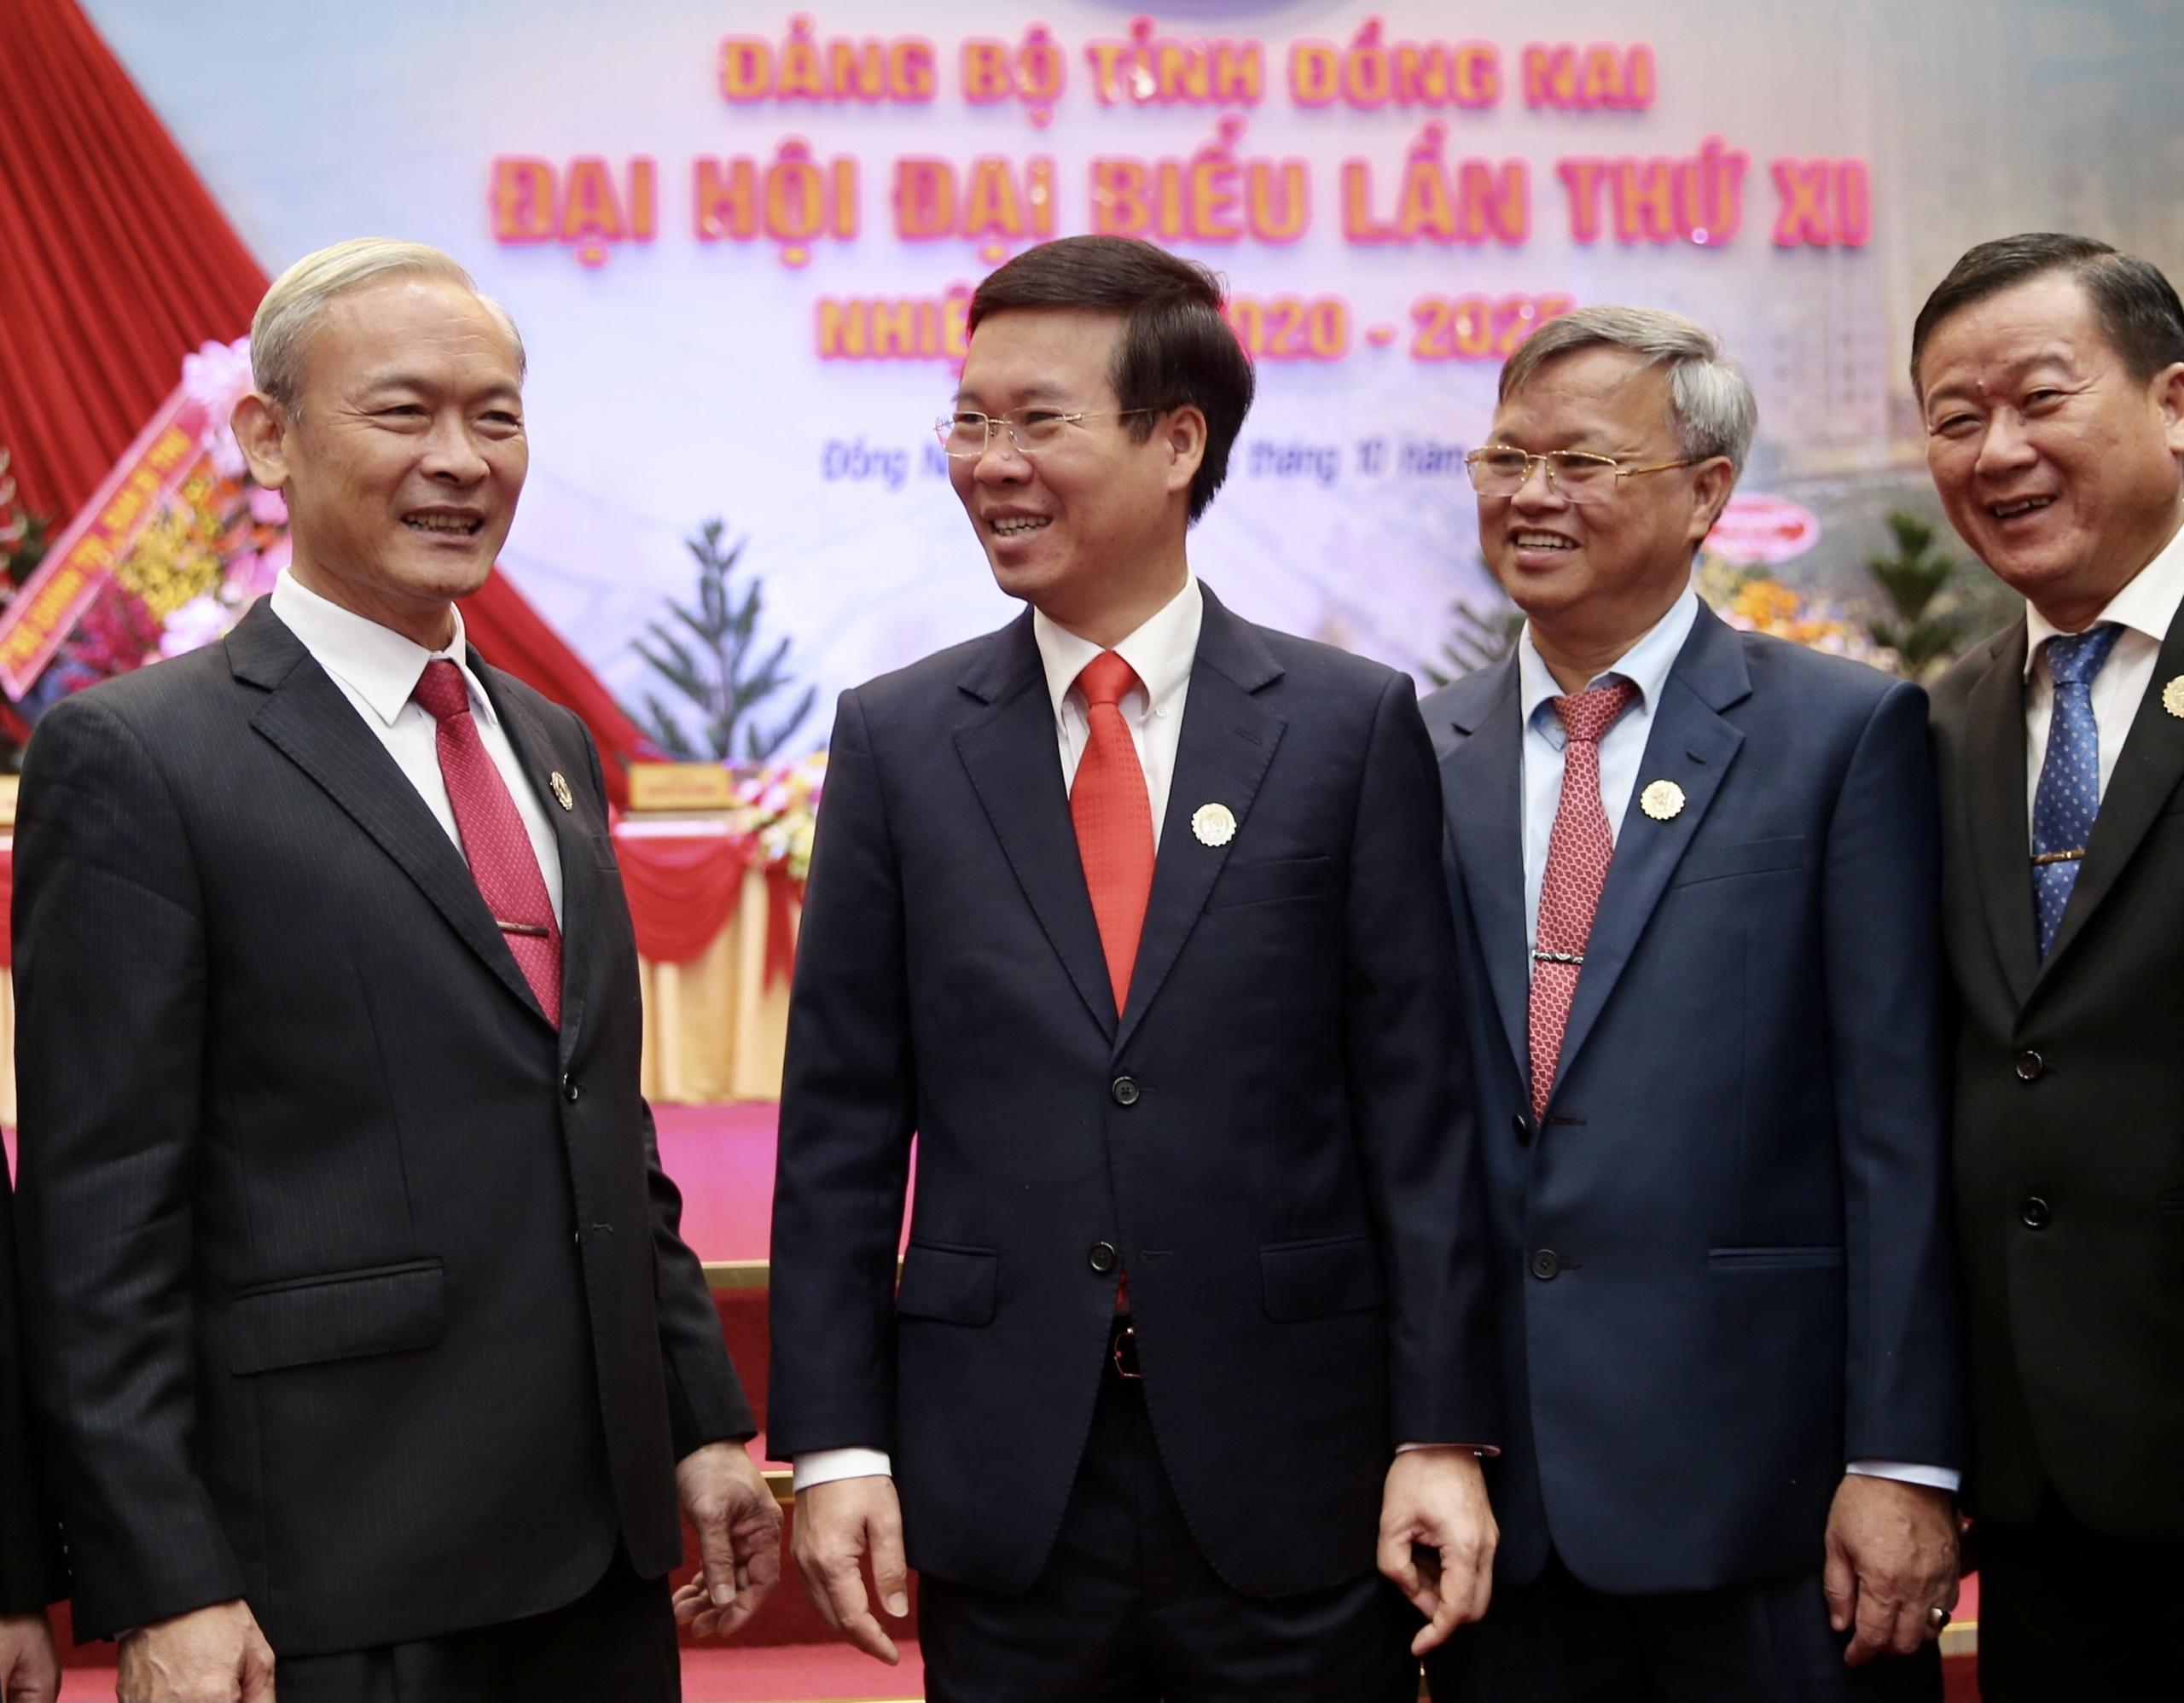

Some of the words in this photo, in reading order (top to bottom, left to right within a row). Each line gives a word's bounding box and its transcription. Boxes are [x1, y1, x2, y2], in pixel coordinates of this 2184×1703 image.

[723, 16, 933, 100] ĐẢNG
[963, 25, 1063, 124] BỘ
[1087, 18, 1263, 102] TỈNH
[1523, 43, 1654, 106] NAI
[491, 154, 654, 265] ĐẠI
[694, 137, 858, 265] HỘI
[894, 155, 1057, 264] ĐẠI
[1093, 113, 1310, 243] BIỂU
[1556, 136, 1749, 243] THỨ
[1774, 159, 1869, 243] XI
[818, 284, 968, 376] NHIỆ
[1229, 293, 1350, 359] 020
